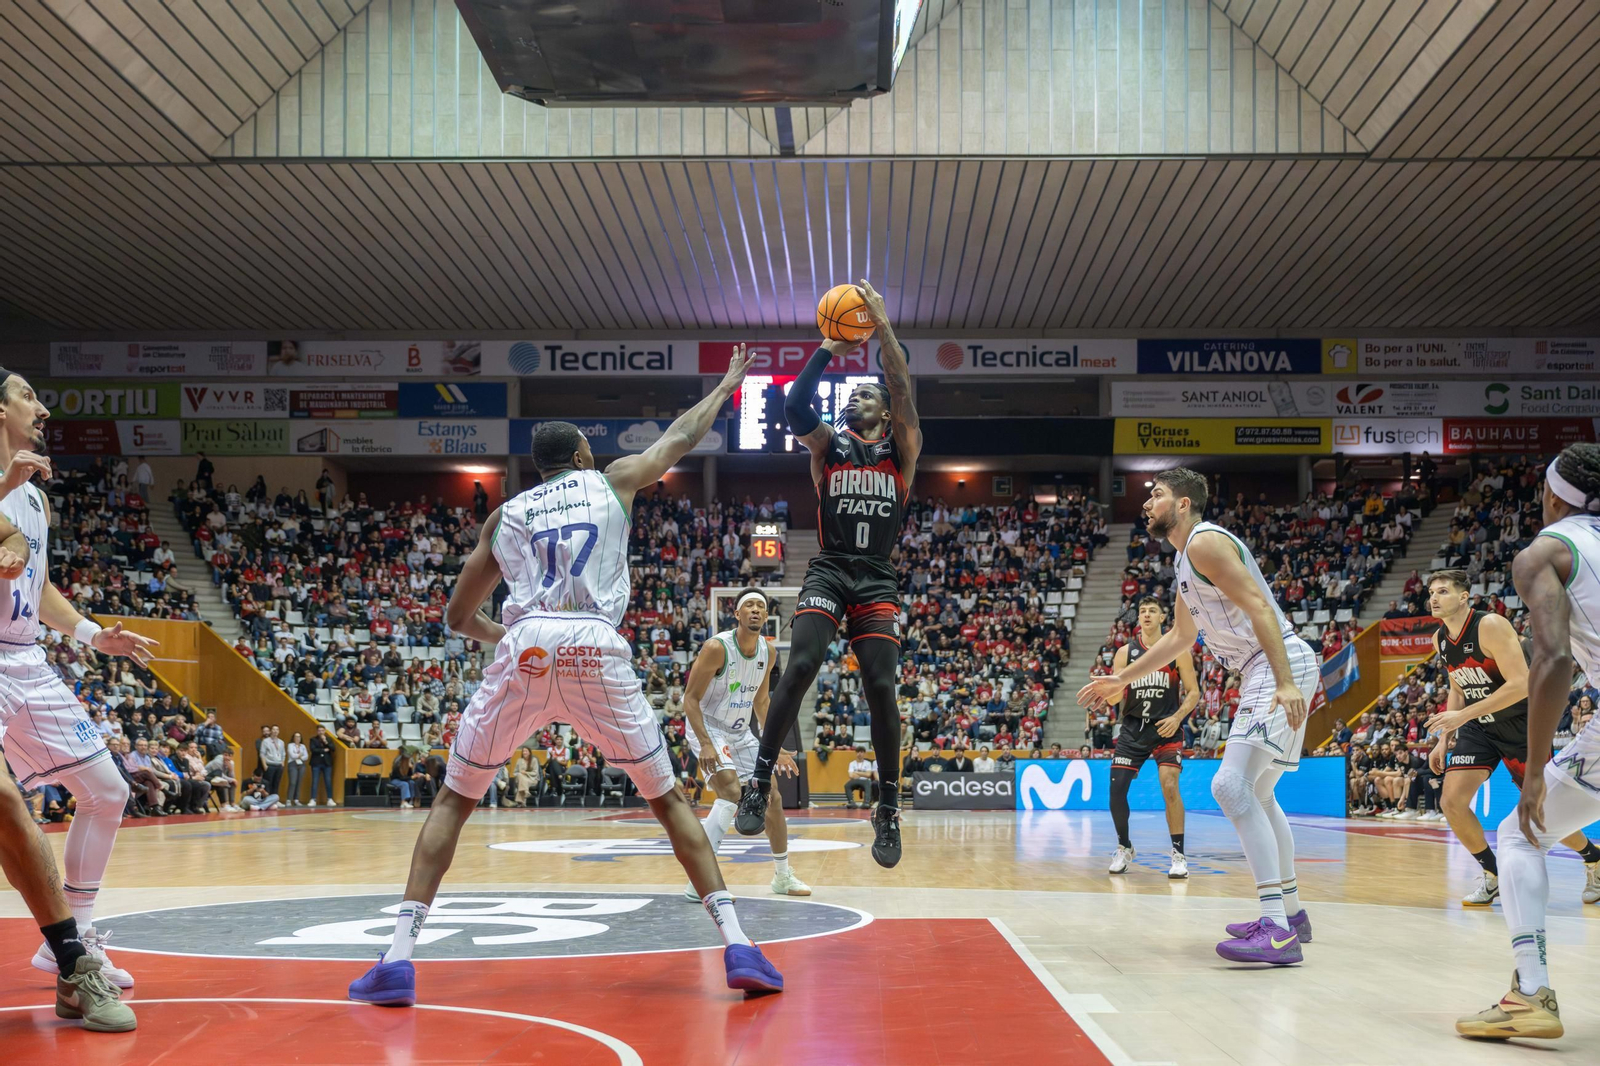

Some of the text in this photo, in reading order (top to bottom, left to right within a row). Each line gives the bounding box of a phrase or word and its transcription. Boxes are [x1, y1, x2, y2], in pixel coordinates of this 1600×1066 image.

[1203, 342, 1255, 351] CATERING
[1365, 343, 1447, 355] Bo per a l'UNI.
[307, 354, 372, 367] FRISELVA
[544, 344, 672, 371] Tecnical
[967, 345, 1117, 368] Tecnical meat
[1167, 351, 1292, 372] VILANOVA
[1365, 356, 1460, 368] Bo per a la salut.
[139, 365, 186, 374] esportcat
[1547, 362, 1594, 372] esportcat
[213, 390, 254, 404] VVR
[1181, 390, 1220, 403] SANT
[1222, 390, 1267, 403] ANIOL
[1520, 385, 1561, 400] Sant
[1336, 405, 1384, 414] VALENT
[1520, 403, 1549, 413] Food
[133, 425, 143, 446] 5
[184, 422, 221, 441] Prat
[226, 421, 283, 442] Sàbat
[418, 421, 477, 441] Estanys
[1153, 426, 1189, 436] Grues
[1363, 426, 1439, 444] fustech
[1450, 427, 1539, 440] BAUHAUS
[351, 445, 360, 453] la
[445, 438, 487, 453] Blaus
[1153, 437, 1201, 448] Viñolas
[829, 469, 897, 503] GIRONA
[836, 498, 893, 518] FIATC
[855, 522, 870, 549] 0
[530, 522, 599, 588] 77
[753, 539, 777, 558] 15
[809, 596, 837, 614] YOSOY
[556, 646, 602, 658] COSTA
[556, 659, 603, 668] DEL SOL
[556, 668, 604, 678] MÁLAGA
[1135, 688, 1165, 699] FIATC
[1462, 686, 1492, 700] FIATC
[1142, 700, 1151, 717] 2
[731, 717, 745, 730] 6
[1114, 756, 1132, 766] YOSOY
[1451, 755, 1476, 765] YOSOY
[916, 776, 1012, 797] endesa
